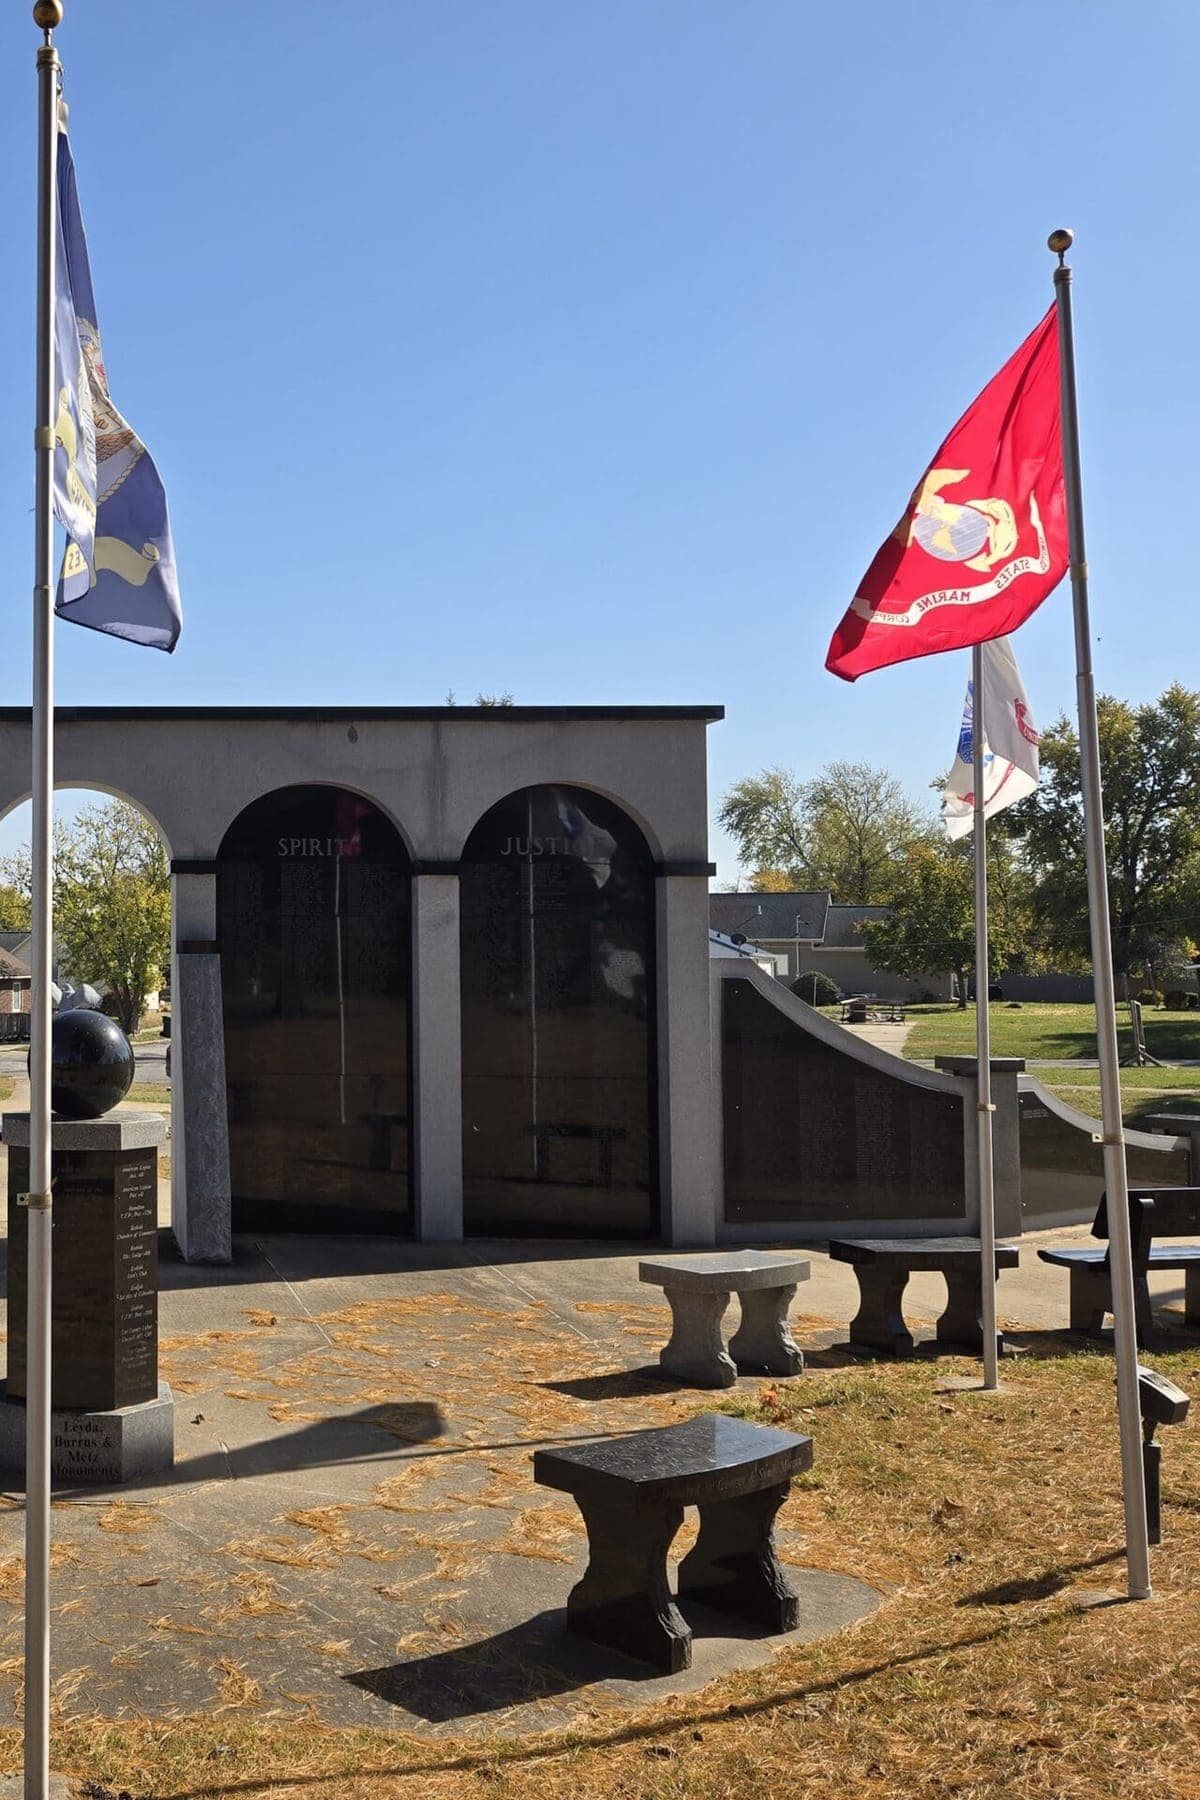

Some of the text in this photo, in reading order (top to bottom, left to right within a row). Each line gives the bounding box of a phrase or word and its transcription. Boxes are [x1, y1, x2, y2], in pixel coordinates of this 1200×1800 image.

[277, 838, 348, 856] SPIRIT
[64, 1421, 103, 1435] Leyda,
[55, 1436, 112, 1448] Burrus &
[68, 1451, 98, 1463] Metz
